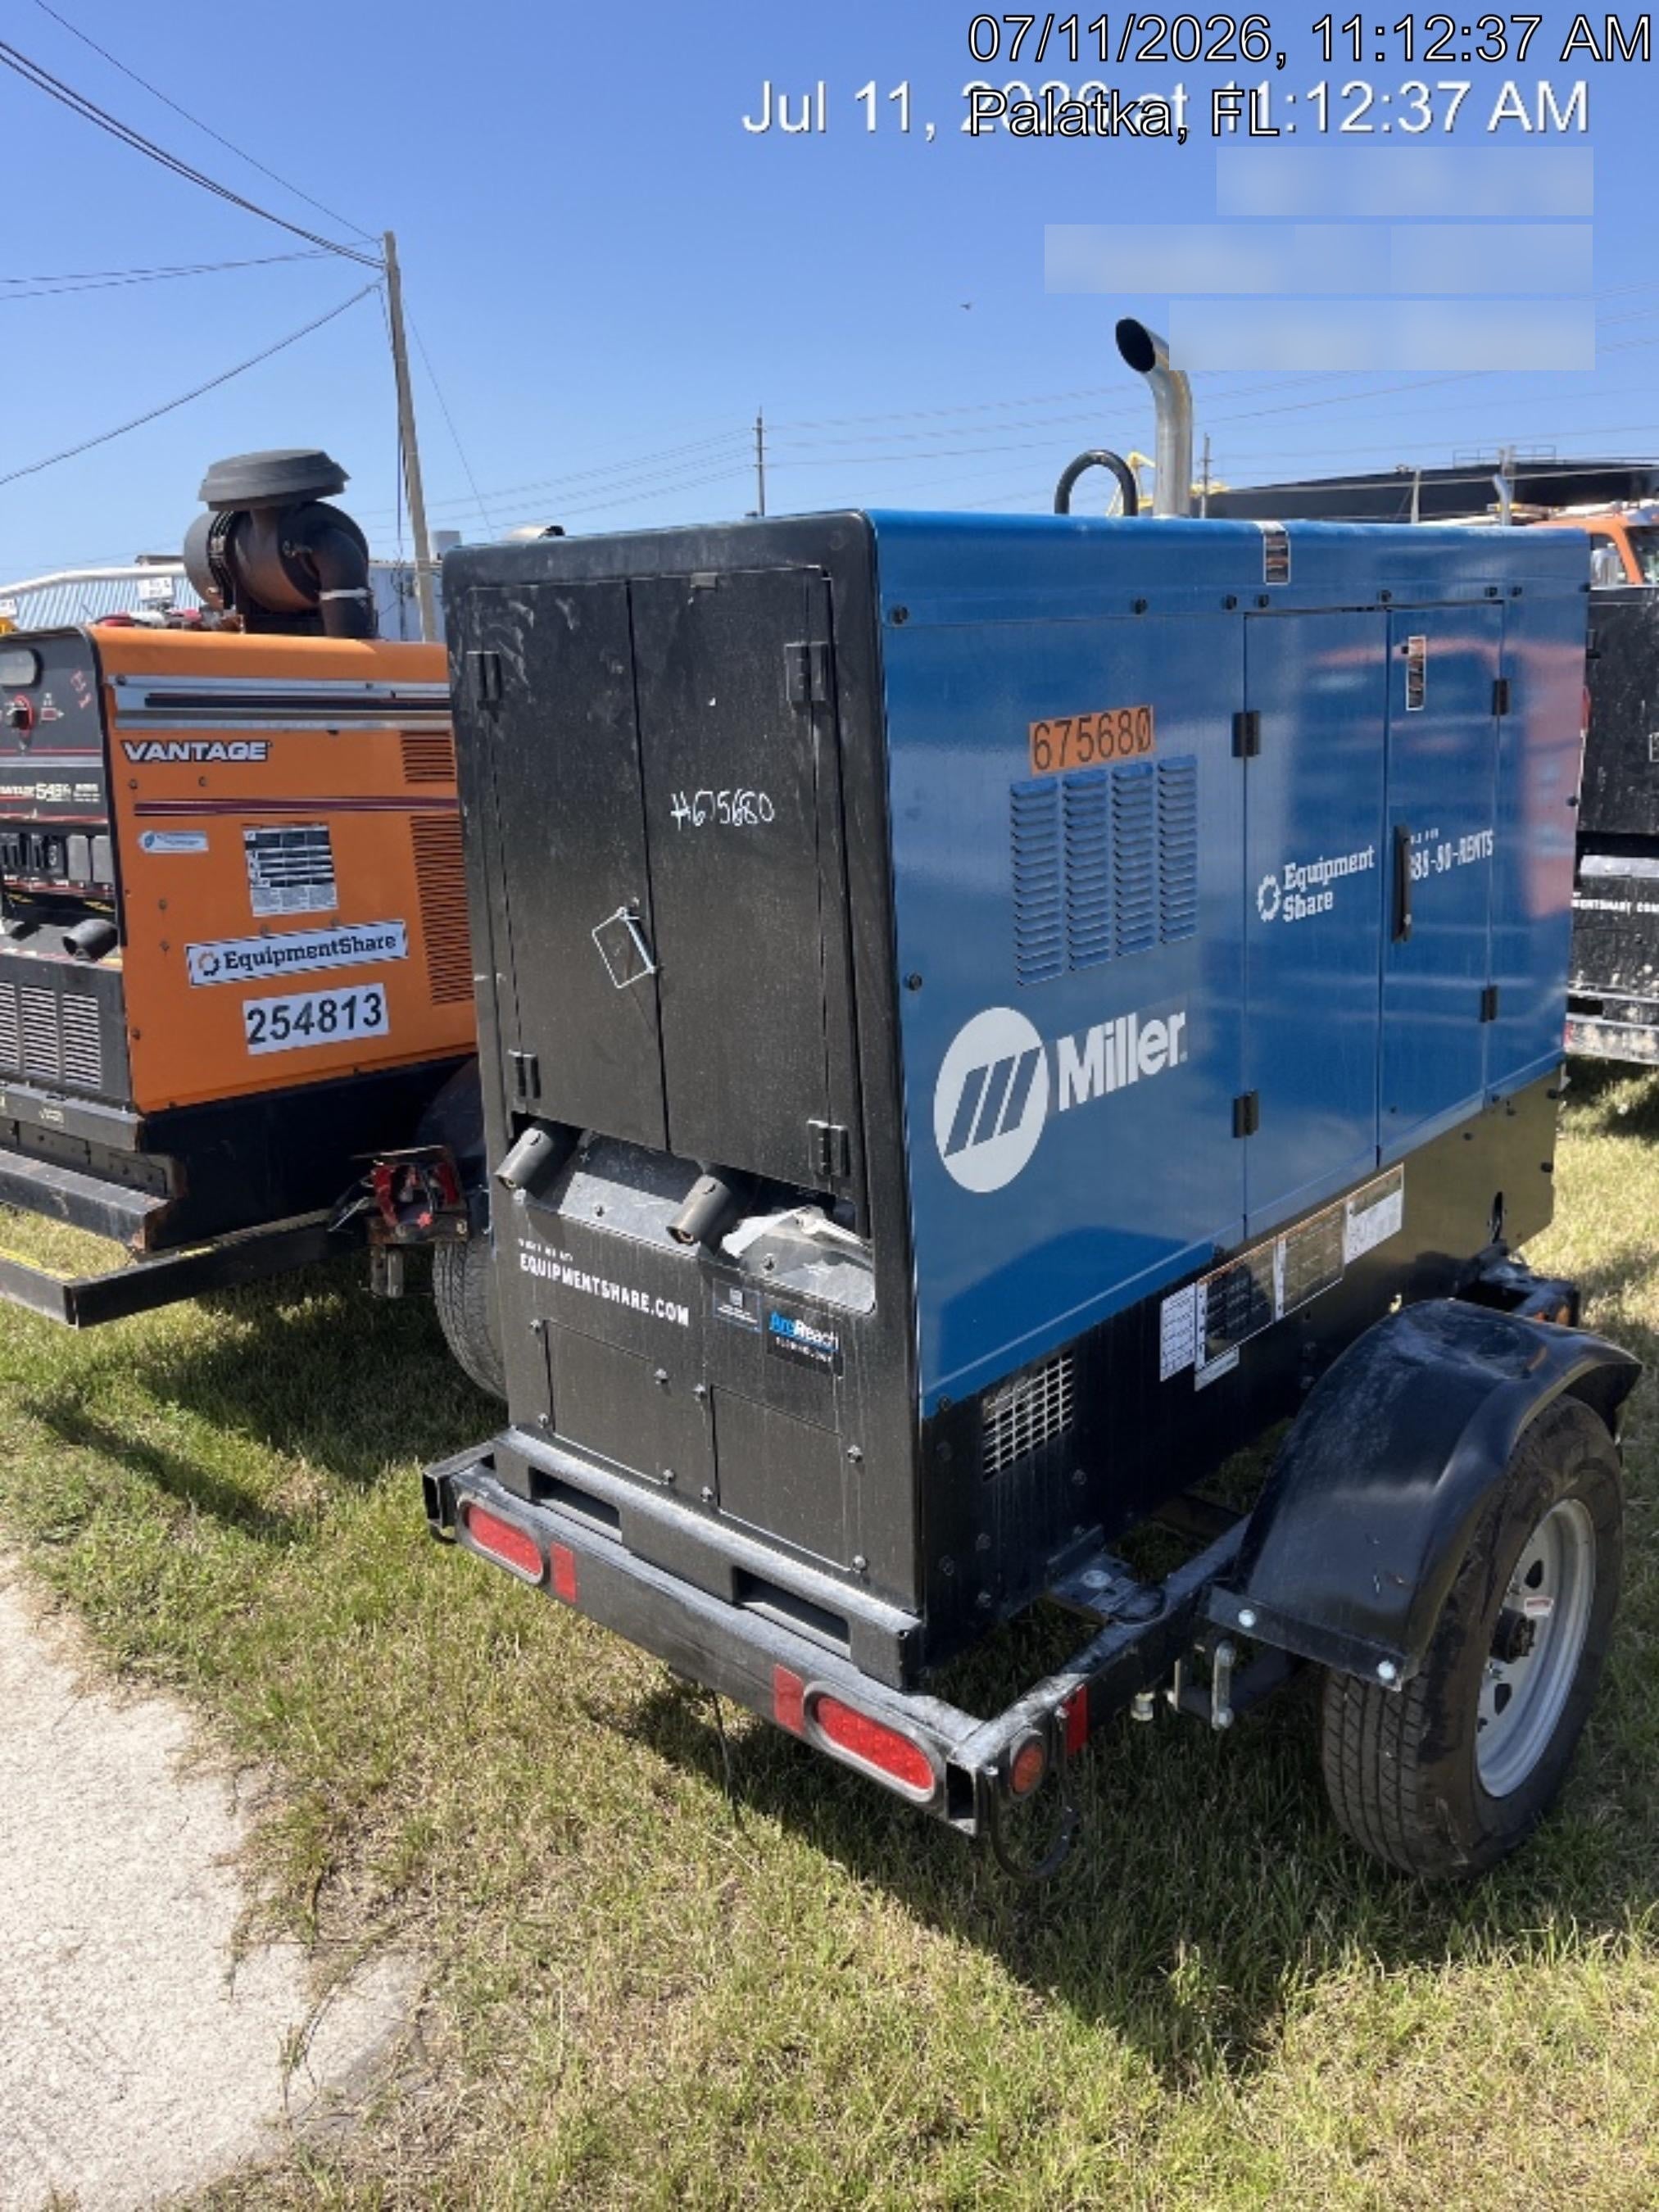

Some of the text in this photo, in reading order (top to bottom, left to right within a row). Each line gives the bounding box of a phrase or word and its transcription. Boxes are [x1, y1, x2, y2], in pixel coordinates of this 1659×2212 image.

[123, 741, 270, 763] VANTAGE
[1034, 707, 1151, 770] 675680
[1283, 845, 1376, 893] Equipment
[1282, 891, 1334, 922] Share
[224, 935, 397, 972] EquipmentShare
[247, 992, 383, 1045] 254813
[1057, 1010, 1186, 1113] Miller
[519, 1253, 690, 1327] EQUIPMENTSHARE.COM
